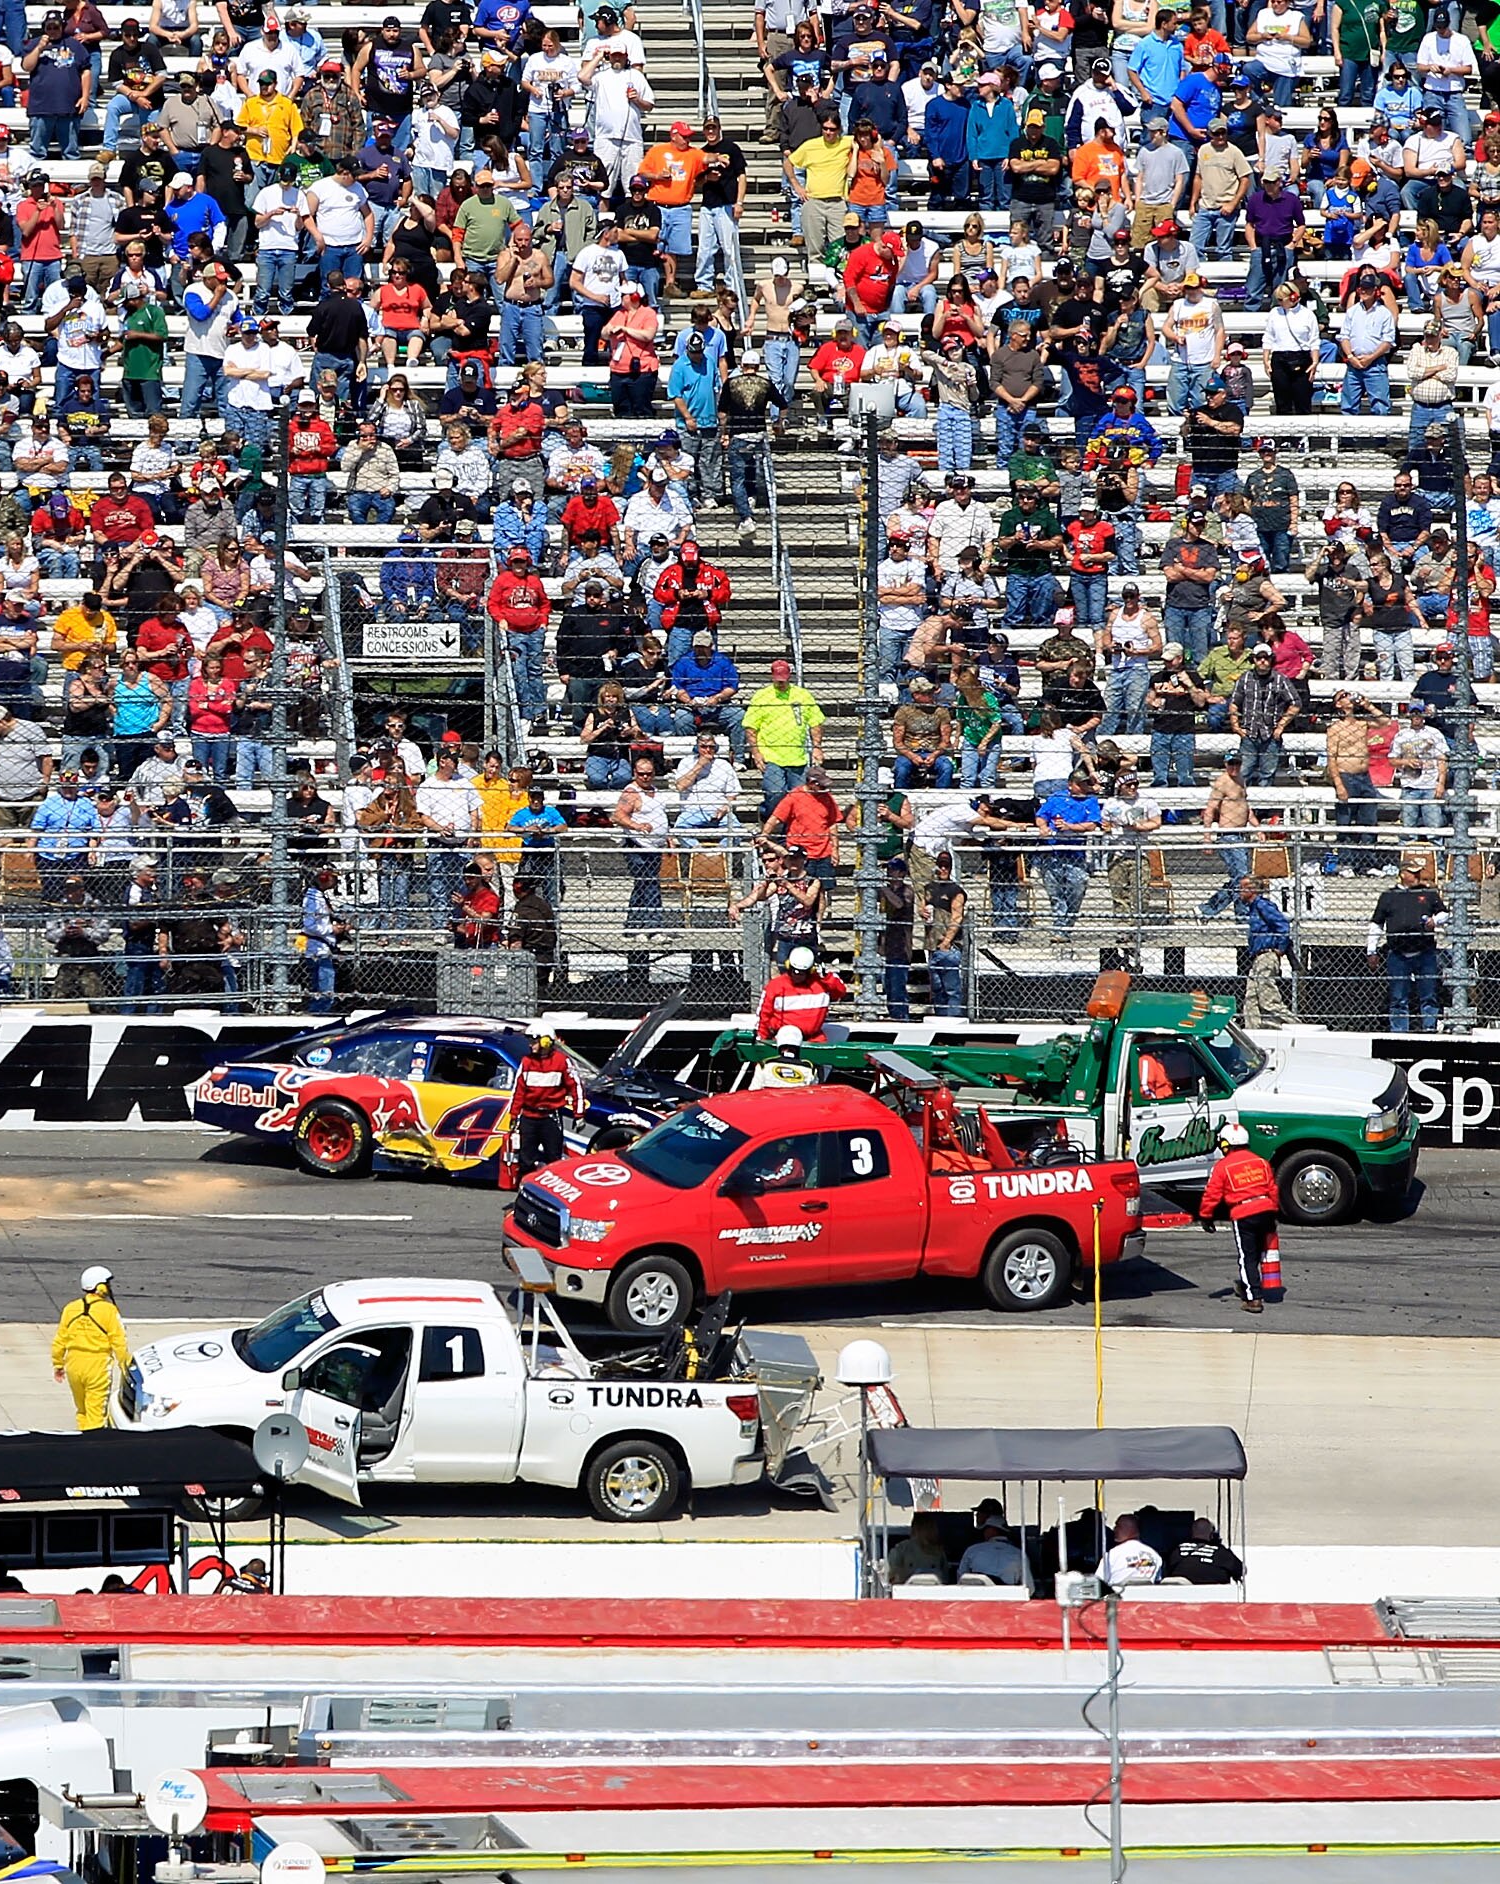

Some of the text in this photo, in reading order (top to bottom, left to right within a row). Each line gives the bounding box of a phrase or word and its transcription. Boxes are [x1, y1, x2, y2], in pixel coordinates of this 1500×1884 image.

[499, 8, 517, 20] 43
[367, 626, 428, 638] RESTROOMS
[367, 641, 438, 653] CONCESSIONS
[792, 920, 813, 934] 14
[198, 1080, 276, 1107] Red Bull
[696, 1110, 729, 1133] TOYOTA
[850, 1137, 874, 1175] 3
[534, 1170, 584, 1203] TOYOTA
[983, 1169, 1093, 1199] TUNDRA
[748, 1253, 787, 1262] TUNDRA
[446, 1335, 464, 1373] 1
[587, 1387, 703, 1409] TUNDRA
[65, 1486, 141, 1498] CATERPILLAR
